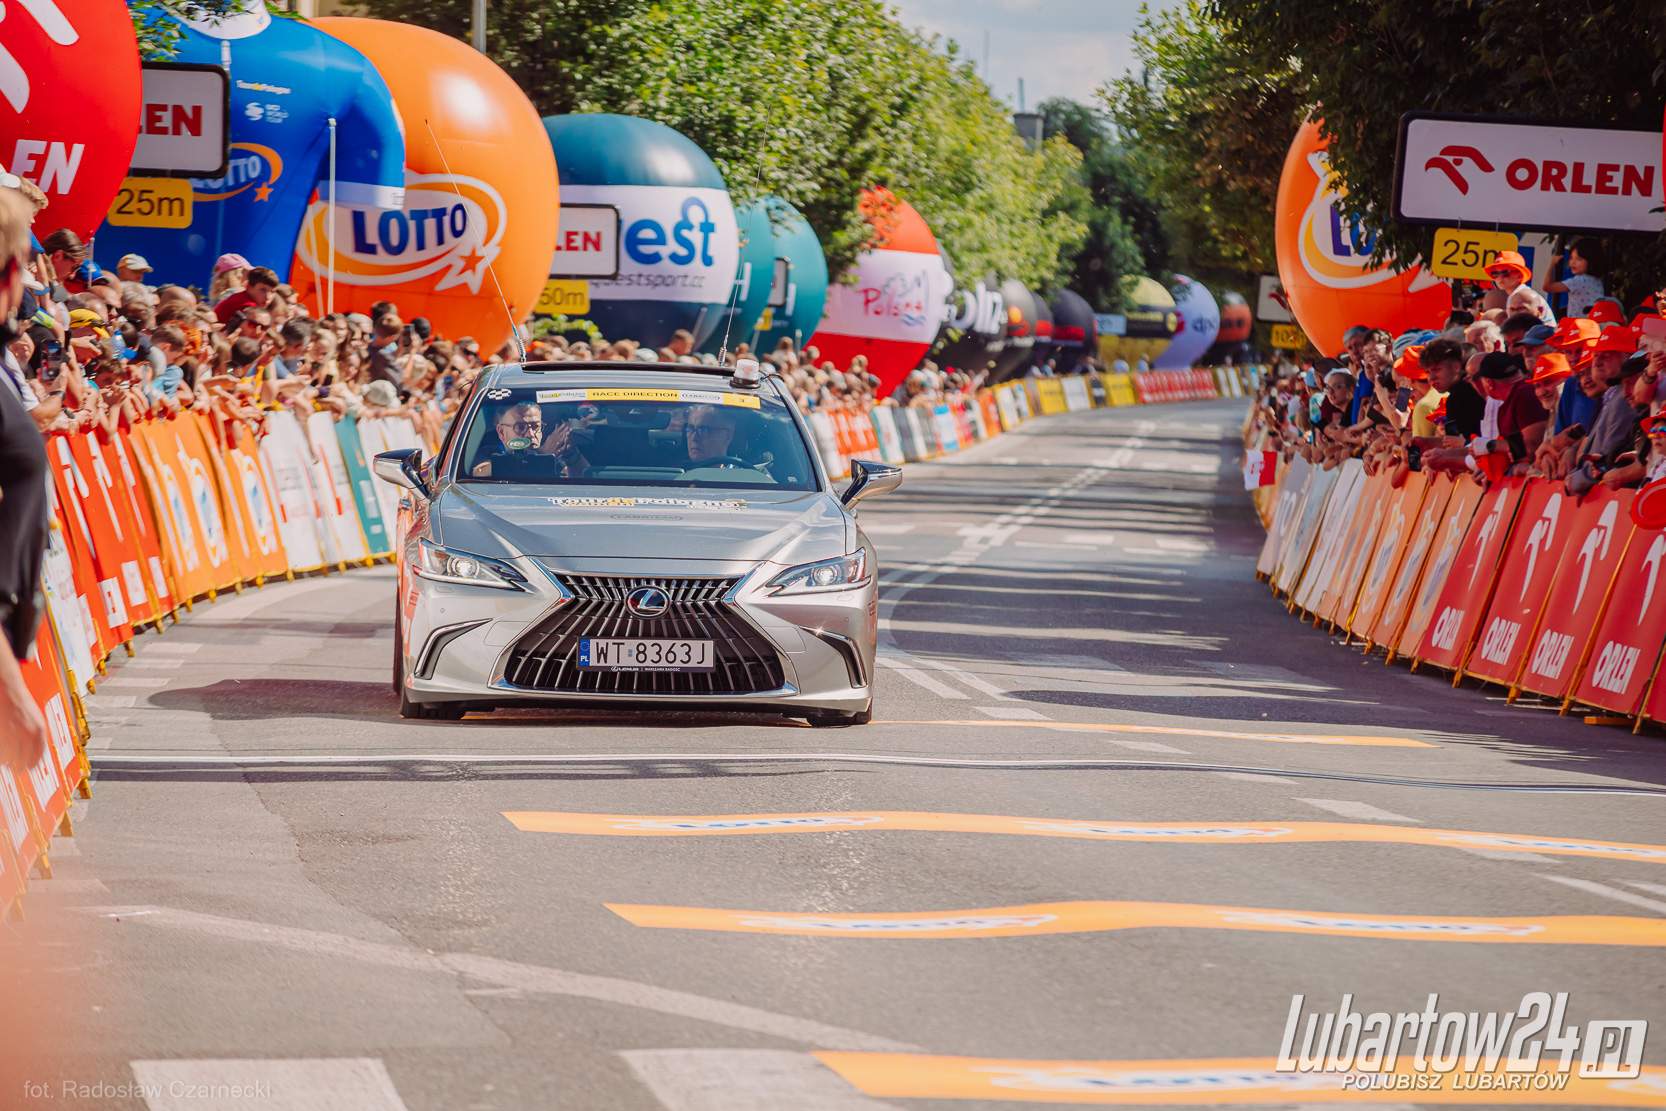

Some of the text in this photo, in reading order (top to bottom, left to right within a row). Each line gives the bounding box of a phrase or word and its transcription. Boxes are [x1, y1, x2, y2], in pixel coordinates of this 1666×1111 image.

[139, 103, 203, 136] EN
[1506, 158, 1655, 198] ORLEN
[116, 188, 185, 217] 25m
[352, 203, 466, 256] LOTTO
[556, 231, 603, 252] EN
[541, 287, 585, 306] 50m
[592, 390, 621, 398] RACE
[623, 390, 678, 399] DIRECTION
[595, 641, 705, 665] WT 8363J
[1481, 616, 1522, 666] ORLEN
[1531, 628, 1575, 680] ORLEN
[1592, 640, 1641, 695] ORLEN
